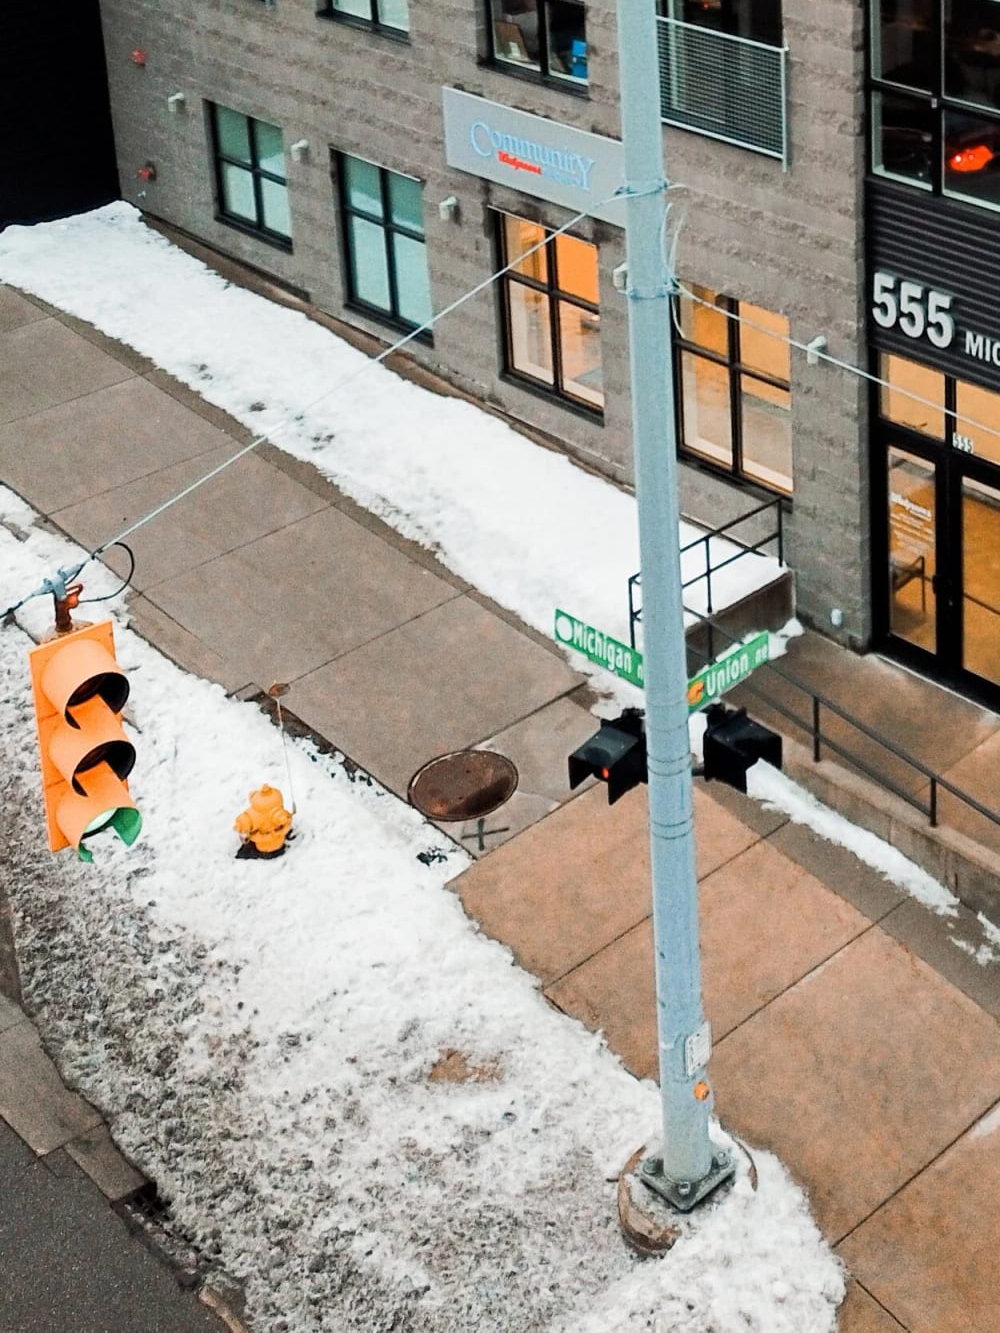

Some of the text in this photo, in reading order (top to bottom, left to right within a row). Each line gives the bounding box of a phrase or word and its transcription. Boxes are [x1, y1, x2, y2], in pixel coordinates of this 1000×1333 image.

[872, 272, 955, 349] 555
[953, 432, 974, 455] 555
[573, 621, 632, 674] Michigan
[707, 653, 748, 695] Union
